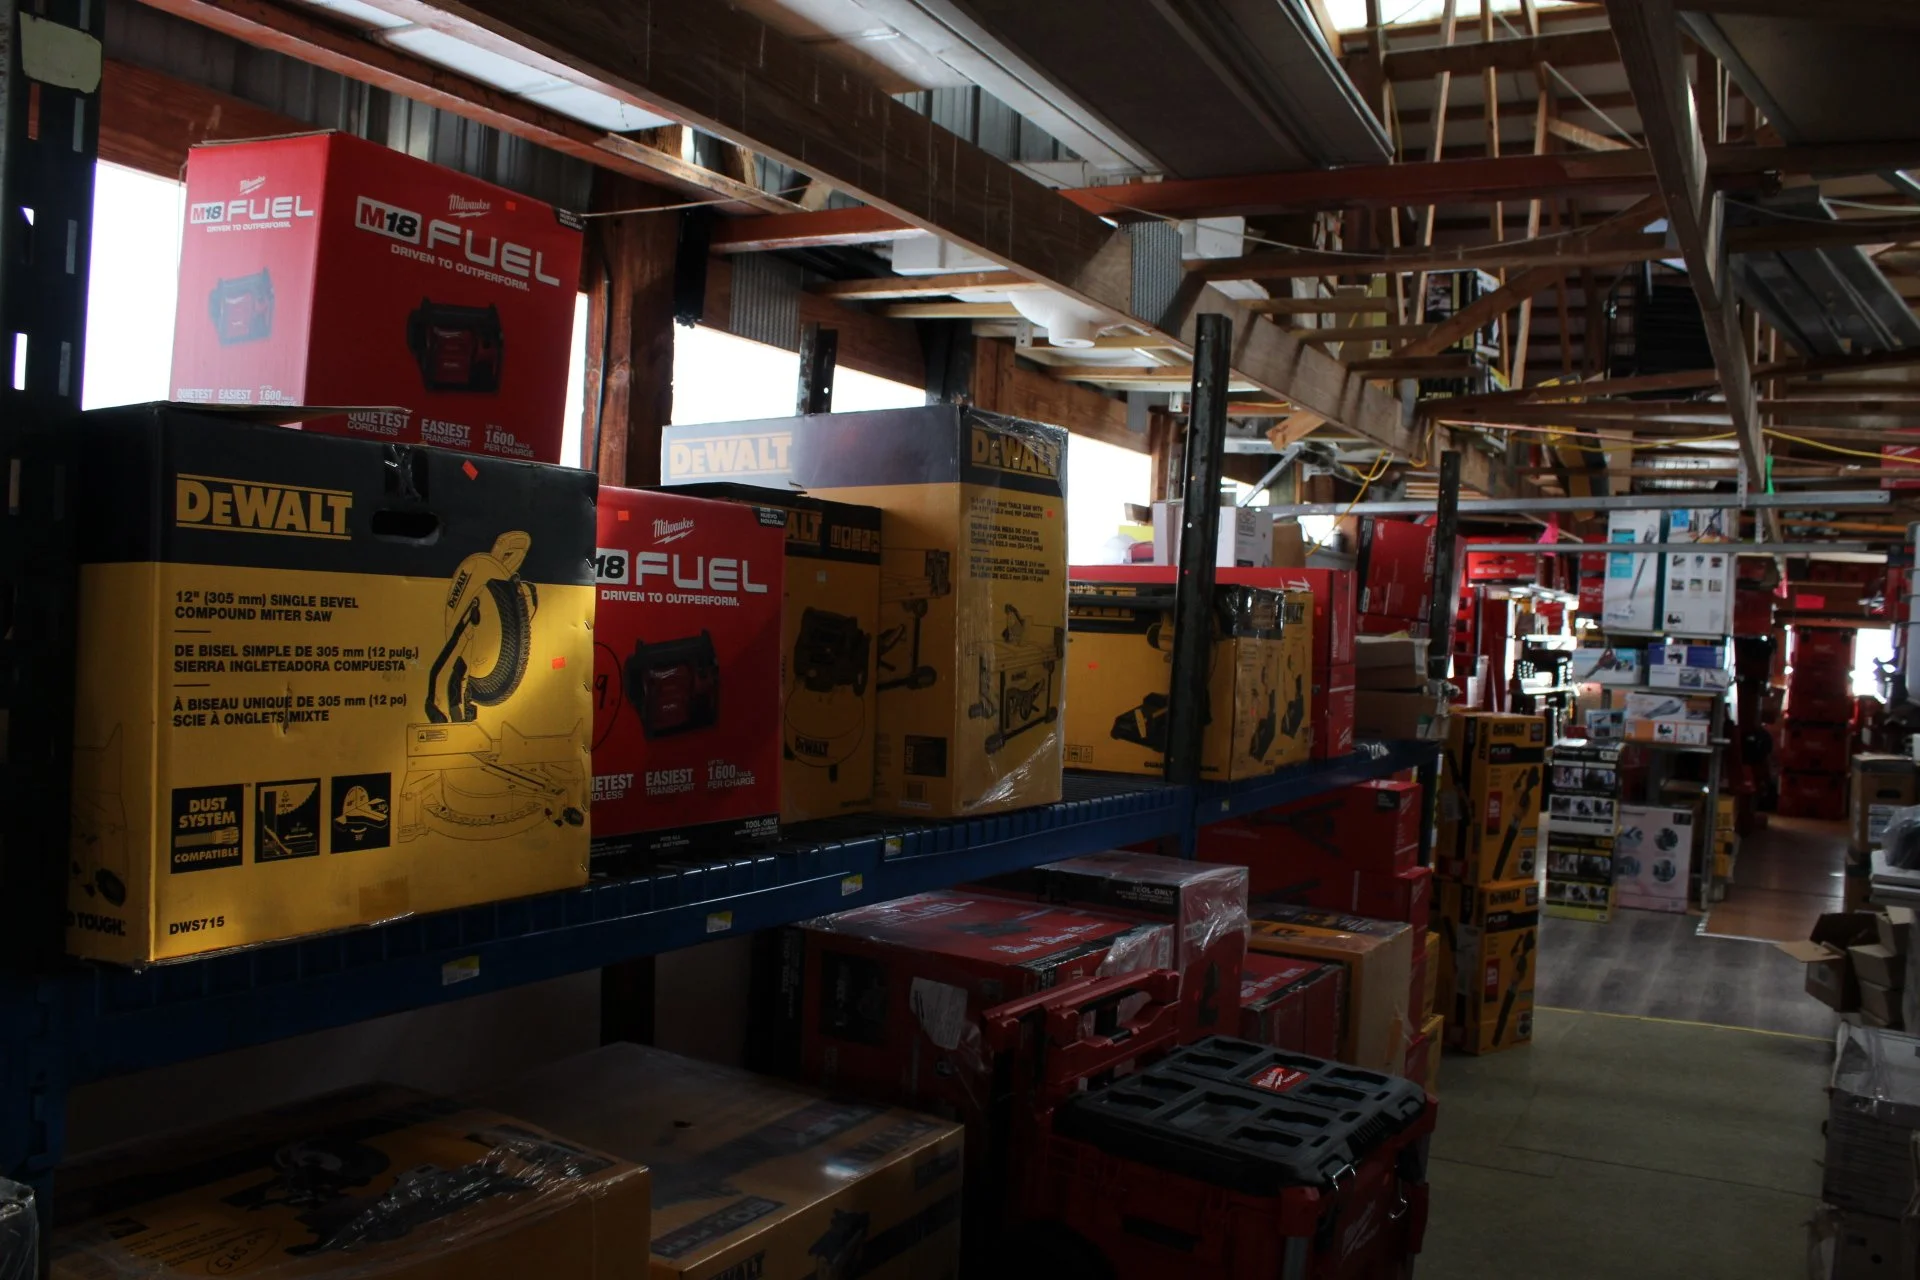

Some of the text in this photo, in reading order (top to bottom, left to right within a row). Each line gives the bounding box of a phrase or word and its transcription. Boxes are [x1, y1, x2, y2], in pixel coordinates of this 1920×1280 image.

[192, 195, 314, 222] M18 FUEL
[448, 194, 492, 212] Milwaukee
[360, 203, 560, 287] M18 FUEL
[391, 244, 530, 292] DRIVEN TO OUTPERFORM.
[347, 421, 400, 437] CORDLESS
[421, 418, 471, 438] EASIEST
[421, 433, 472, 448] TRANSPORT
[484, 442, 535, 457] PER CHARGE
[651, 516, 695, 538] Milwaukee
[787, 511, 823, 541] ALT
[595, 551, 768, 593] 18 FUEL
[176, 591, 359, 609] 12" (305 mm) SINGLE BEVEL
[601, 590, 740, 607] DRIVEN TO OUTPERFORM.
[175, 606, 332, 622] COMPOUND MITER SAW
[175, 645, 419, 660] DE BISEL SIMPLE DE 305 mm (12 pulg.)
[174, 660, 406, 673] SIERRA INGLETEADORA COMPUESTA
[173, 694, 407, 711] À BISEAU UNIQUE DE 305 mm (12 po)
[173, 710, 330, 727] SCIE À ONGLETS MIXTE
[591, 773, 634, 791] IETEST
[645, 768, 694, 786] EASIEST
[707, 776, 756, 789] PER CHARGE
[591, 789, 624, 802] DLESS
[645, 782, 695, 797] TRANSPORT
[188, 796, 228, 813] DUST
[177, 810, 237, 829] SYSTEM
[173, 846, 240, 864] COMPATIBLE
[169, 916, 225, 935] DWS715
